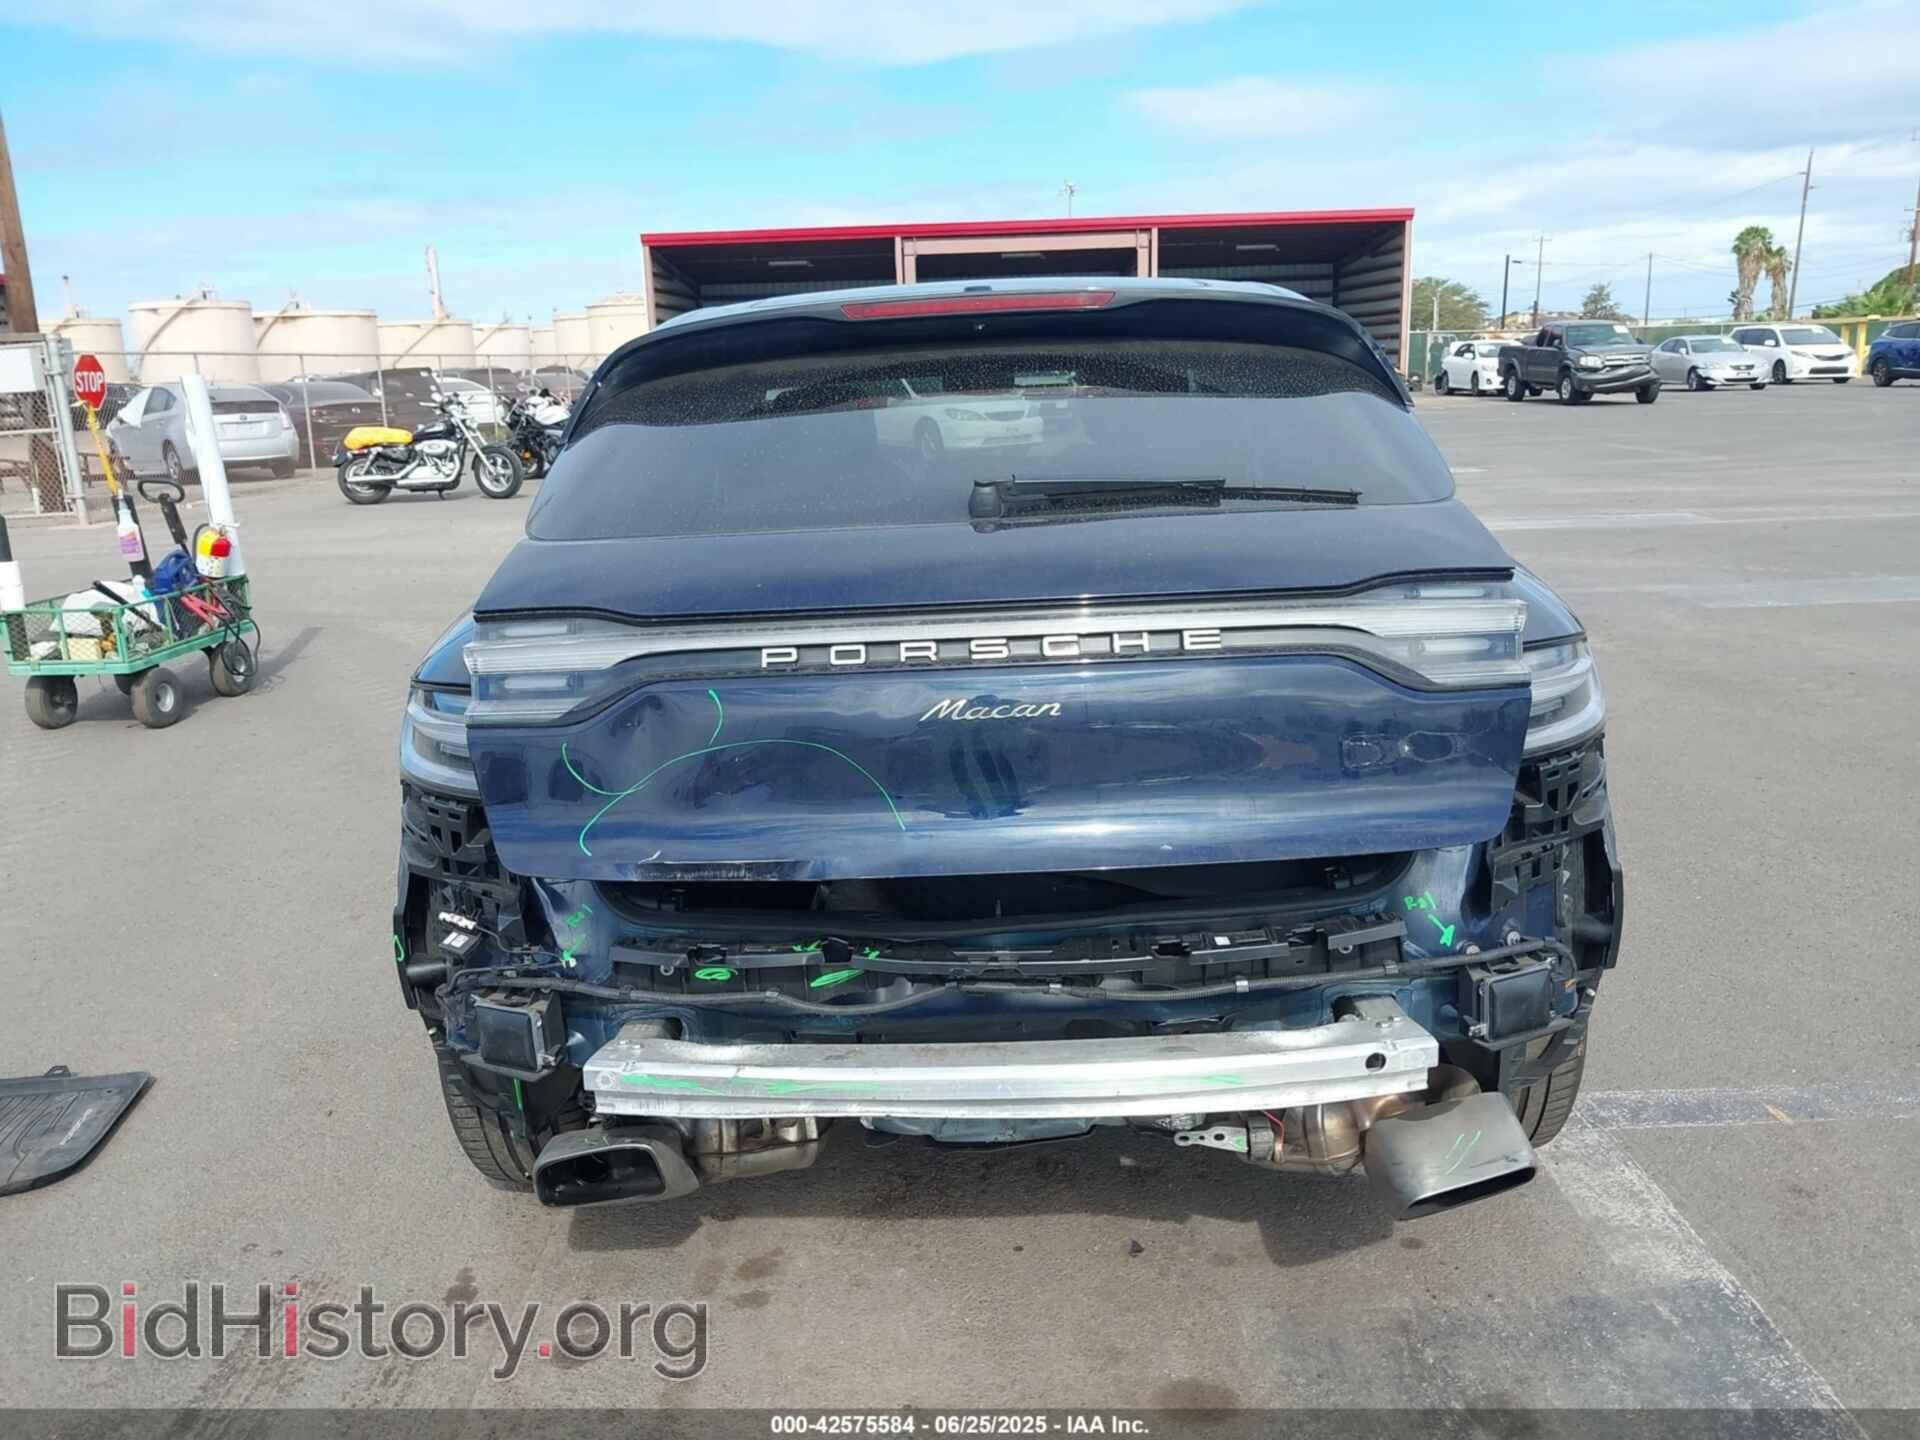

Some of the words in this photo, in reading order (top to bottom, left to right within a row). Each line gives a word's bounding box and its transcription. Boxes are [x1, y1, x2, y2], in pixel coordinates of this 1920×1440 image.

[76, 371, 104, 392] STOP
[760, 628, 1222, 669] PORSCHE
[919, 698, 1062, 722] Macan
